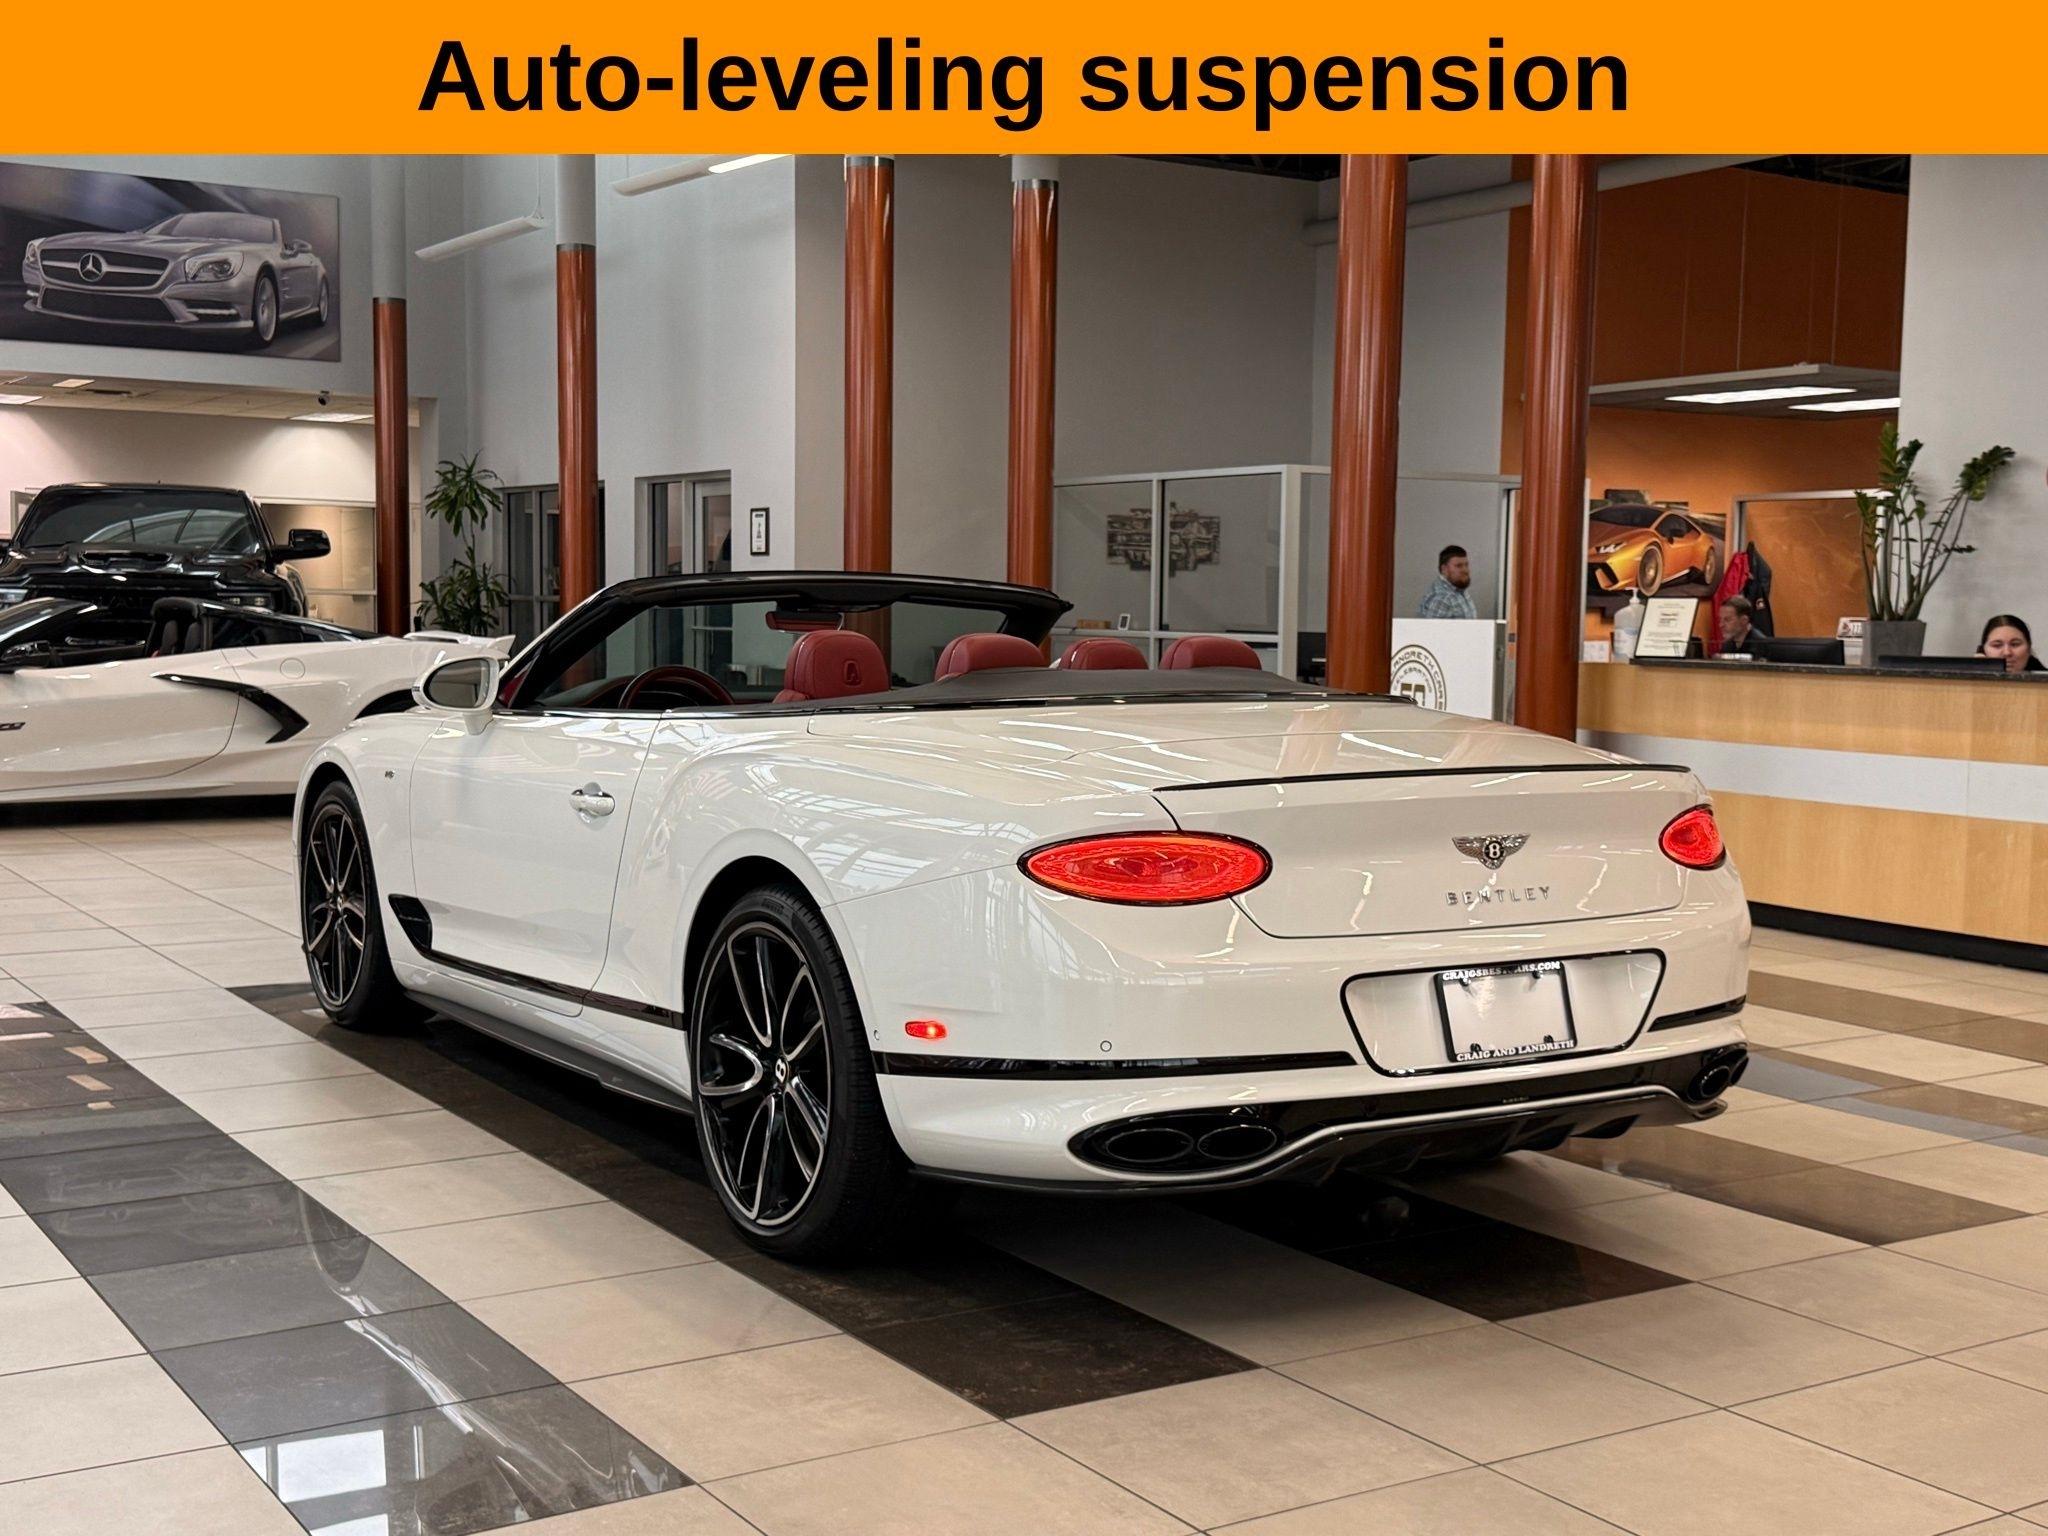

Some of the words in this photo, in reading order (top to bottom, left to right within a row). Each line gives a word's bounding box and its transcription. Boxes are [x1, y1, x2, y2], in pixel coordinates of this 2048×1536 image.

[1392, 651, 1434, 671] ANDRETH
[1446, 886, 1550, 905] BENTLEY
[1442, 961, 1561, 981] CRAIGSBESARS.COM
[1456, 1049, 1491, 1062] CRAIG
[1493, 1047, 1516, 1057] AND
[1518, 1040, 1574, 1054] LANDRETH
